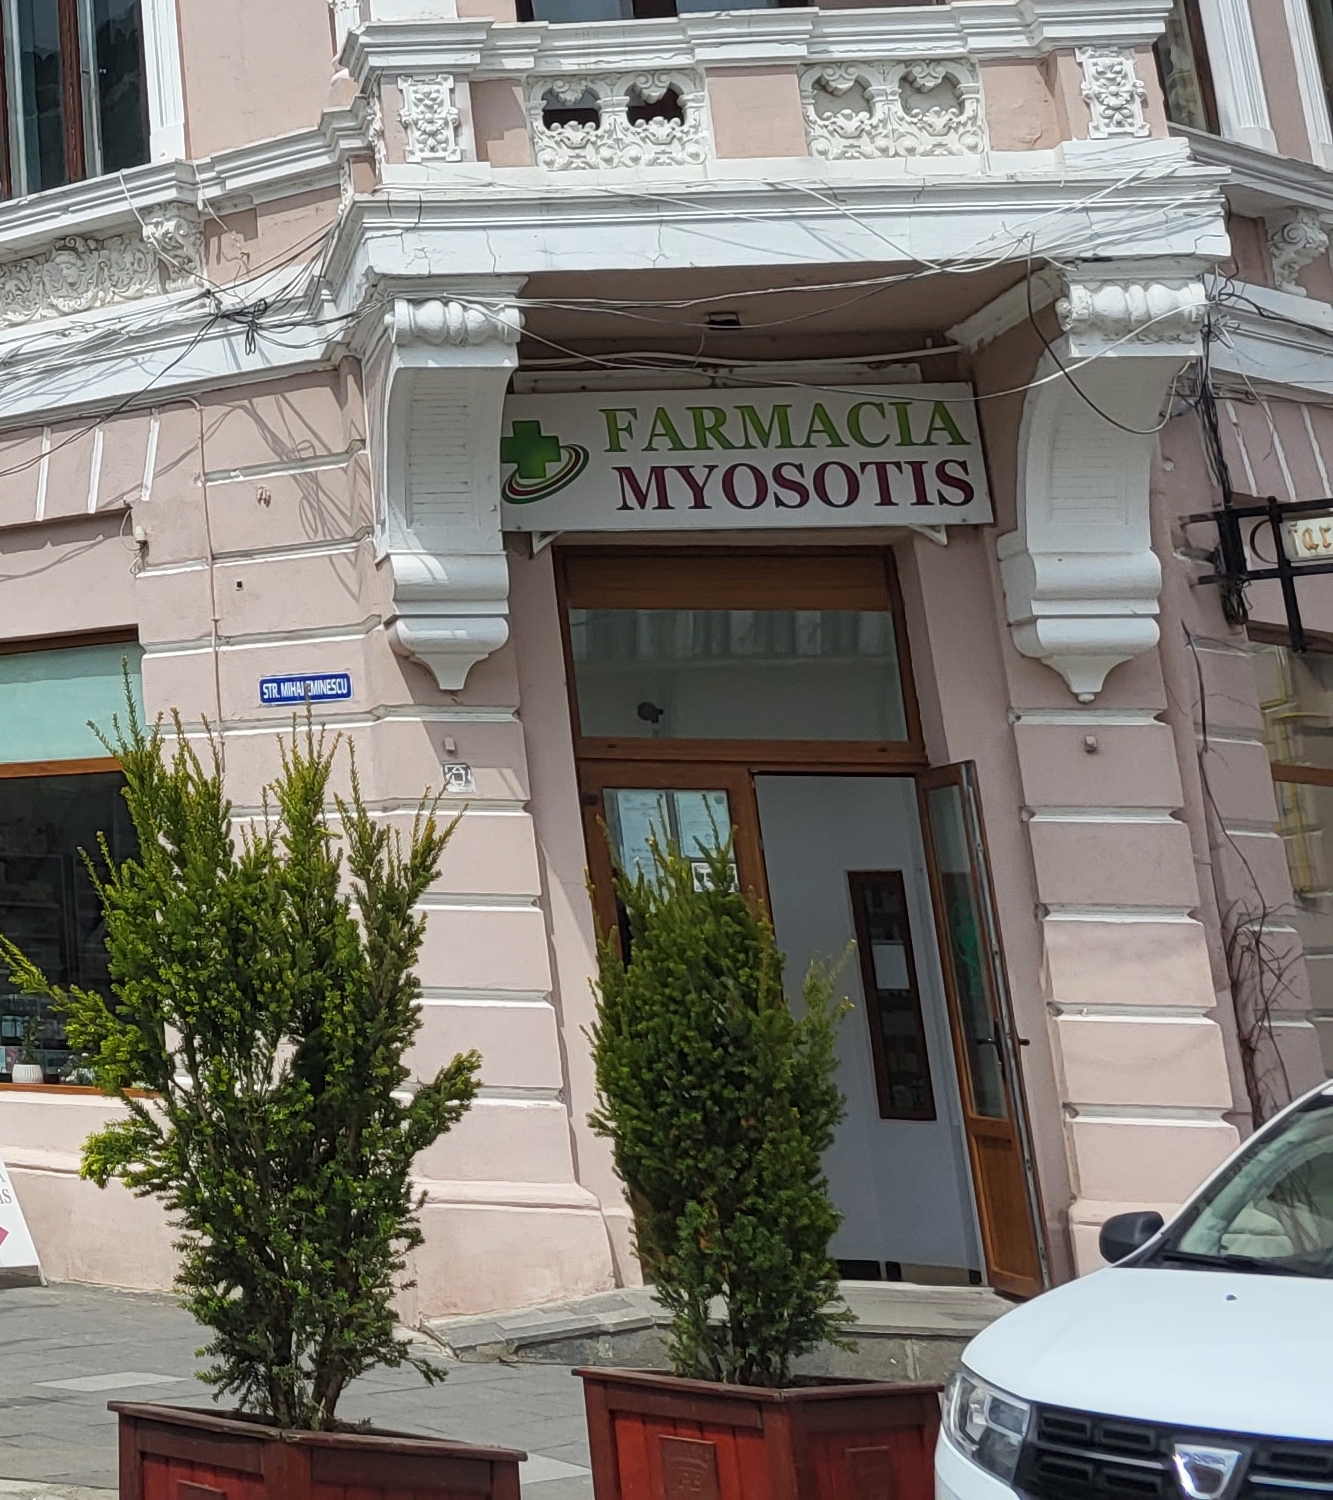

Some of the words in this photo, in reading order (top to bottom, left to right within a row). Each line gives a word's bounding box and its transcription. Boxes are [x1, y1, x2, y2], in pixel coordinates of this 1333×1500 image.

[599, 401, 971, 453] FARMACIA
[611, 459, 975, 511] MYOSOTIS
[263, 683, 279, 698] STR.
[281, 681, 303, 697] MIHAI
